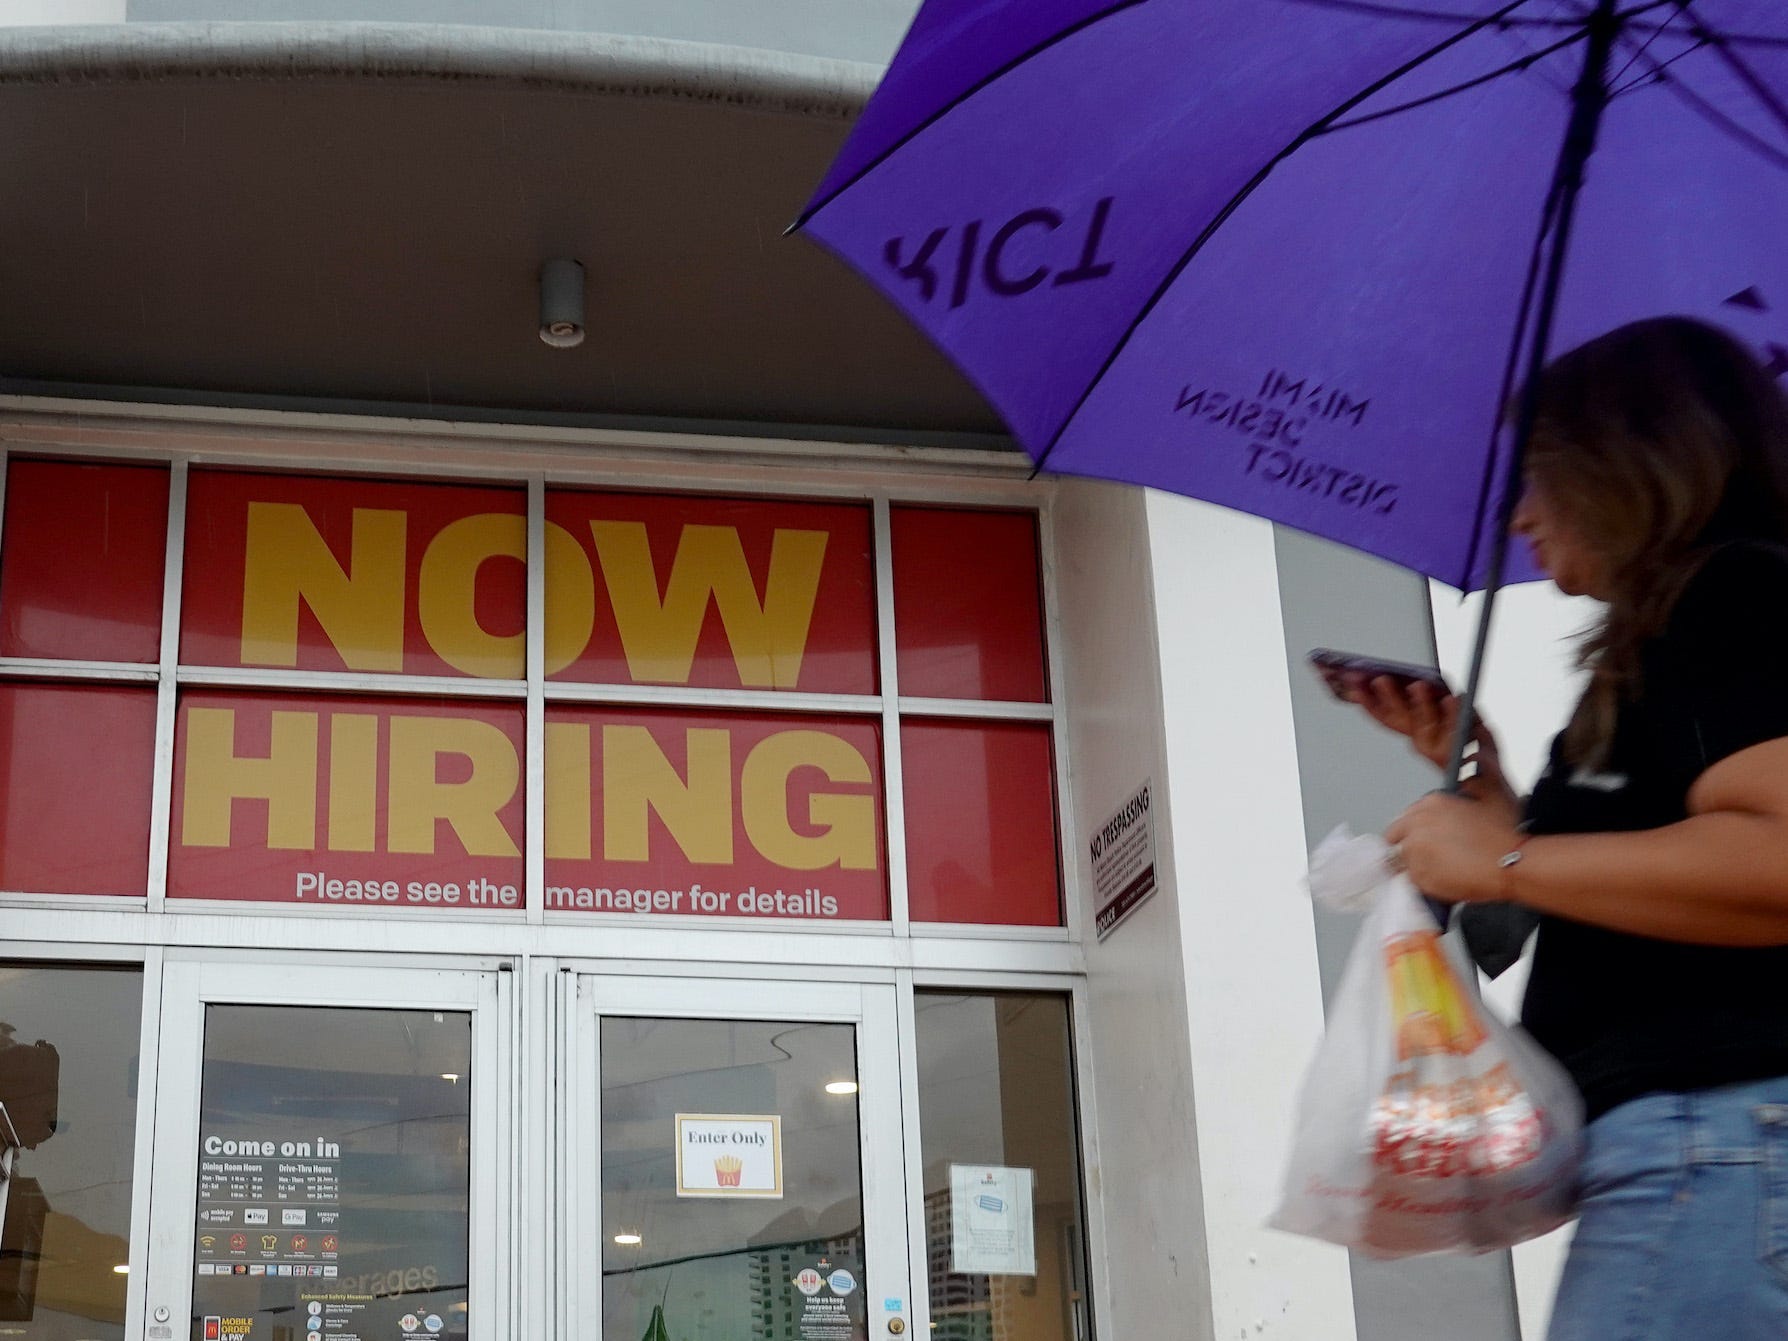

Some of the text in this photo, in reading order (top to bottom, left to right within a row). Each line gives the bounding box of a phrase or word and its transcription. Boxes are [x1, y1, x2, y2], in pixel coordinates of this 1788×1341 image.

[240, 501, 829, 688] NOW
[181, 706, 878, 870] HIRING
[1090, 835, 1101, 864] NO
[1102, 786, 1149, 851] TRESPASSING
[296, 872, 838, 915] Please see the manager for details
[689, 1131, 767, 1147] Enter Only
[205, 1136, 340, 1158] Come on in
[202, 1162, 263, 1173] Dining Room Hours
[279, 1164, 332, 1174] Drive-Thru Hours
[252, 1213, 266, 1221] Pay
[292, 1213, 304, 1221] Pay
[321, 1216, 335, 1224] pay
[806, 1296, 820, 1304] Help
[829, 1296, 844, 1305] keep
[222, 1317, 253, 1326] MOBILE
[221, 1325, 250, 1334] ORDER
[221, 1333, 245, 1341] & PAY
